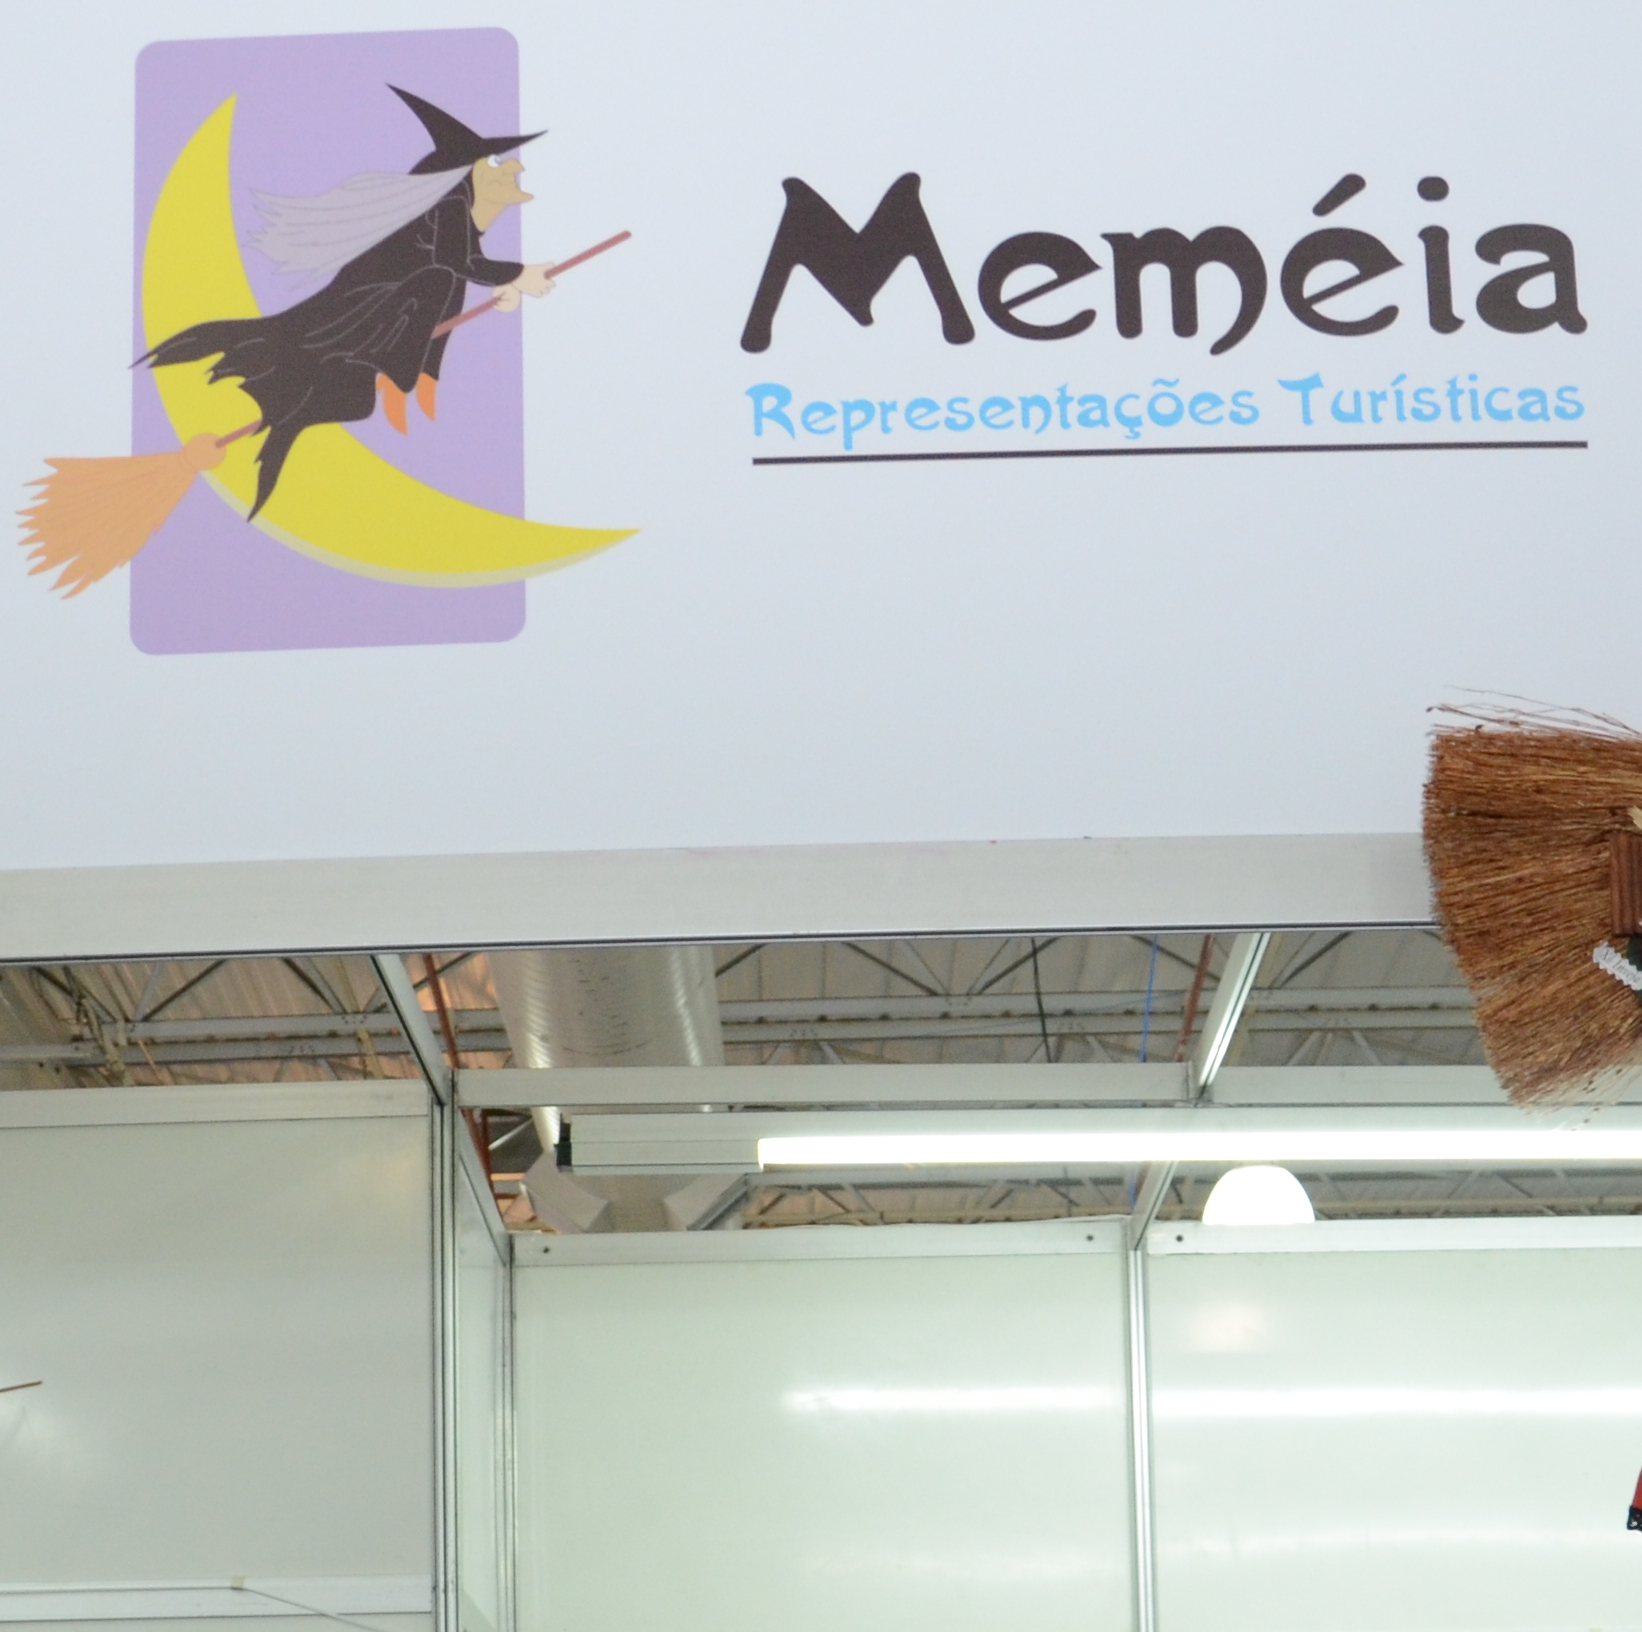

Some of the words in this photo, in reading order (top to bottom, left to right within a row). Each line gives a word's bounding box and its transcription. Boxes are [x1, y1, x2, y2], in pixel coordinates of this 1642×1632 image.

[740, 171, 1588, 355] Meméia
[744, 377, 1261, 450] Representações
[1276, 371, 1587, 427] Turísticas
